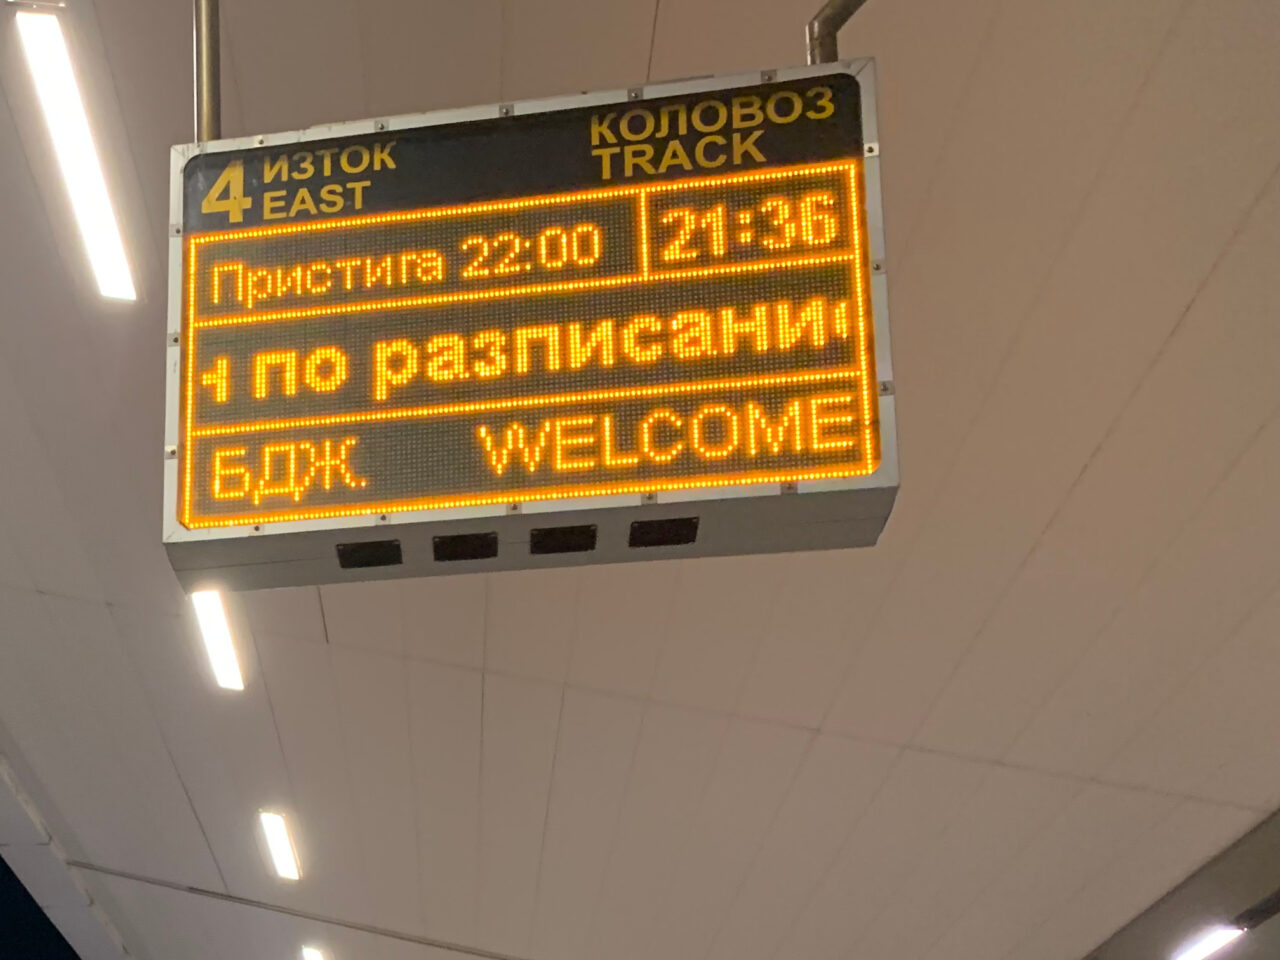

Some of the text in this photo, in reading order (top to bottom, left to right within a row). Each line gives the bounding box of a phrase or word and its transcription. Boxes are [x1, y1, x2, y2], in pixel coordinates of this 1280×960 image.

[590, 86, 835, 146] КОЛОВОЗ
[262, 141, 397, 185] ИЗТОК
[591, 129, 768, 181] TRACK
[201, 158, 252, 223] 4
[262, 180, 372, 220] EAST
[660, 193, 838, 263] 21:36
[211, 224, 601, 309] Пристига 22:00
[253, 345, 349, 400] по
[477, 394, 855, 477] WELCOME
